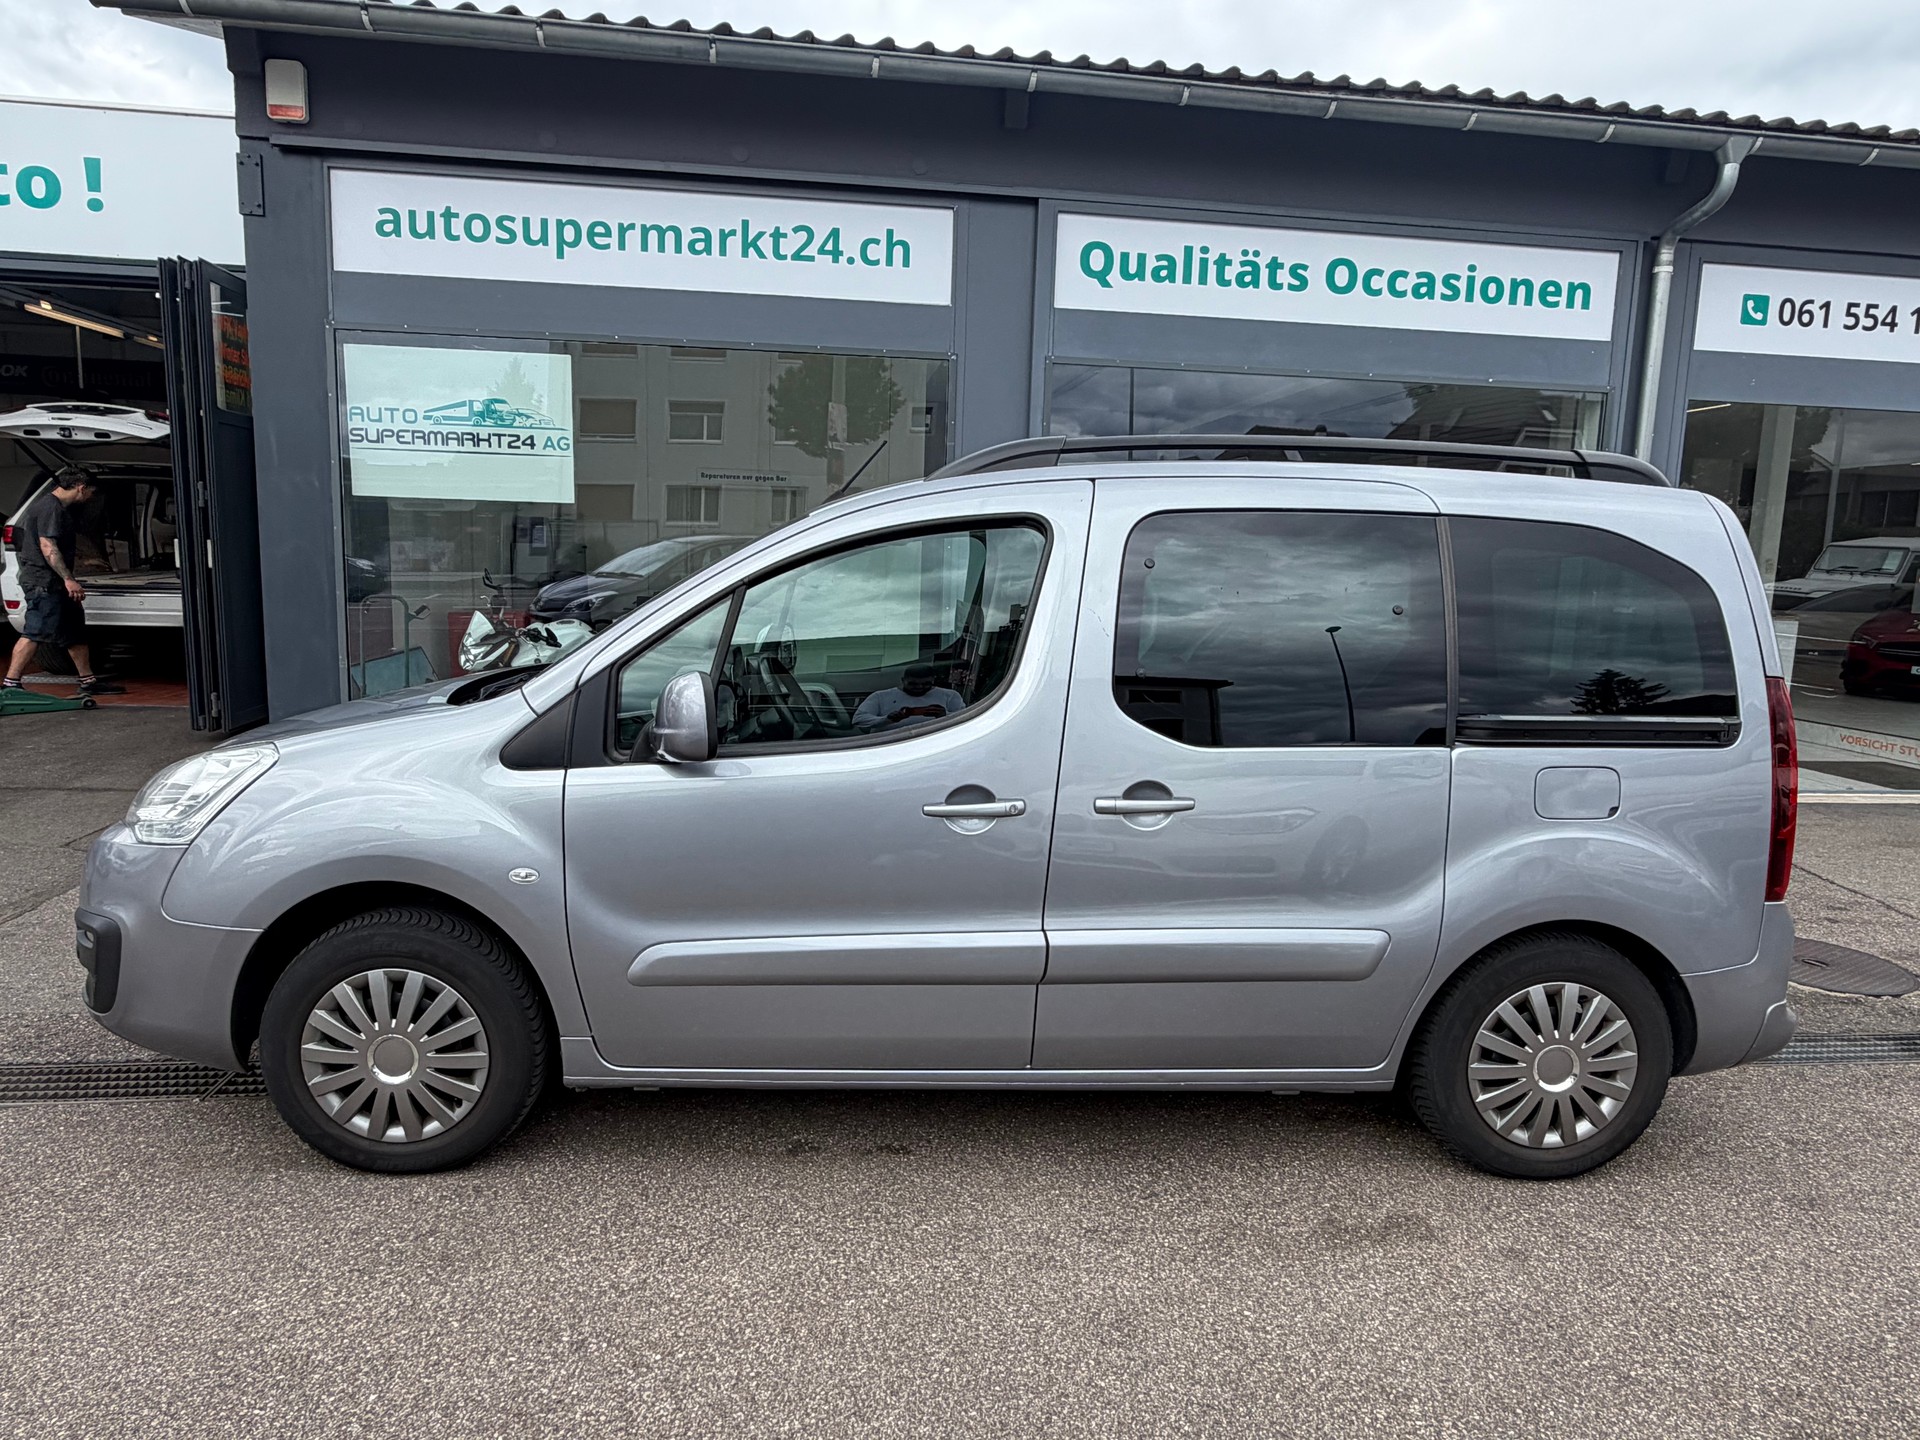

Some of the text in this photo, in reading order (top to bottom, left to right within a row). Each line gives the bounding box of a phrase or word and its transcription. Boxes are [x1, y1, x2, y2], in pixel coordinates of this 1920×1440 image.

[374, 205, 911, 268] autosupermarkt24.ch
[1079, 240, 1592, 311] Qualitäts Occasionen
[1778, 297, 1831, 329] 061
[1843, 302, 1898, 333] 554
[349, 406, 418, 424] AUTO
[349, 427, 570, 451] SUPERMARKT24 AG
[1839, 733, 1898, 752] VORSICHT
